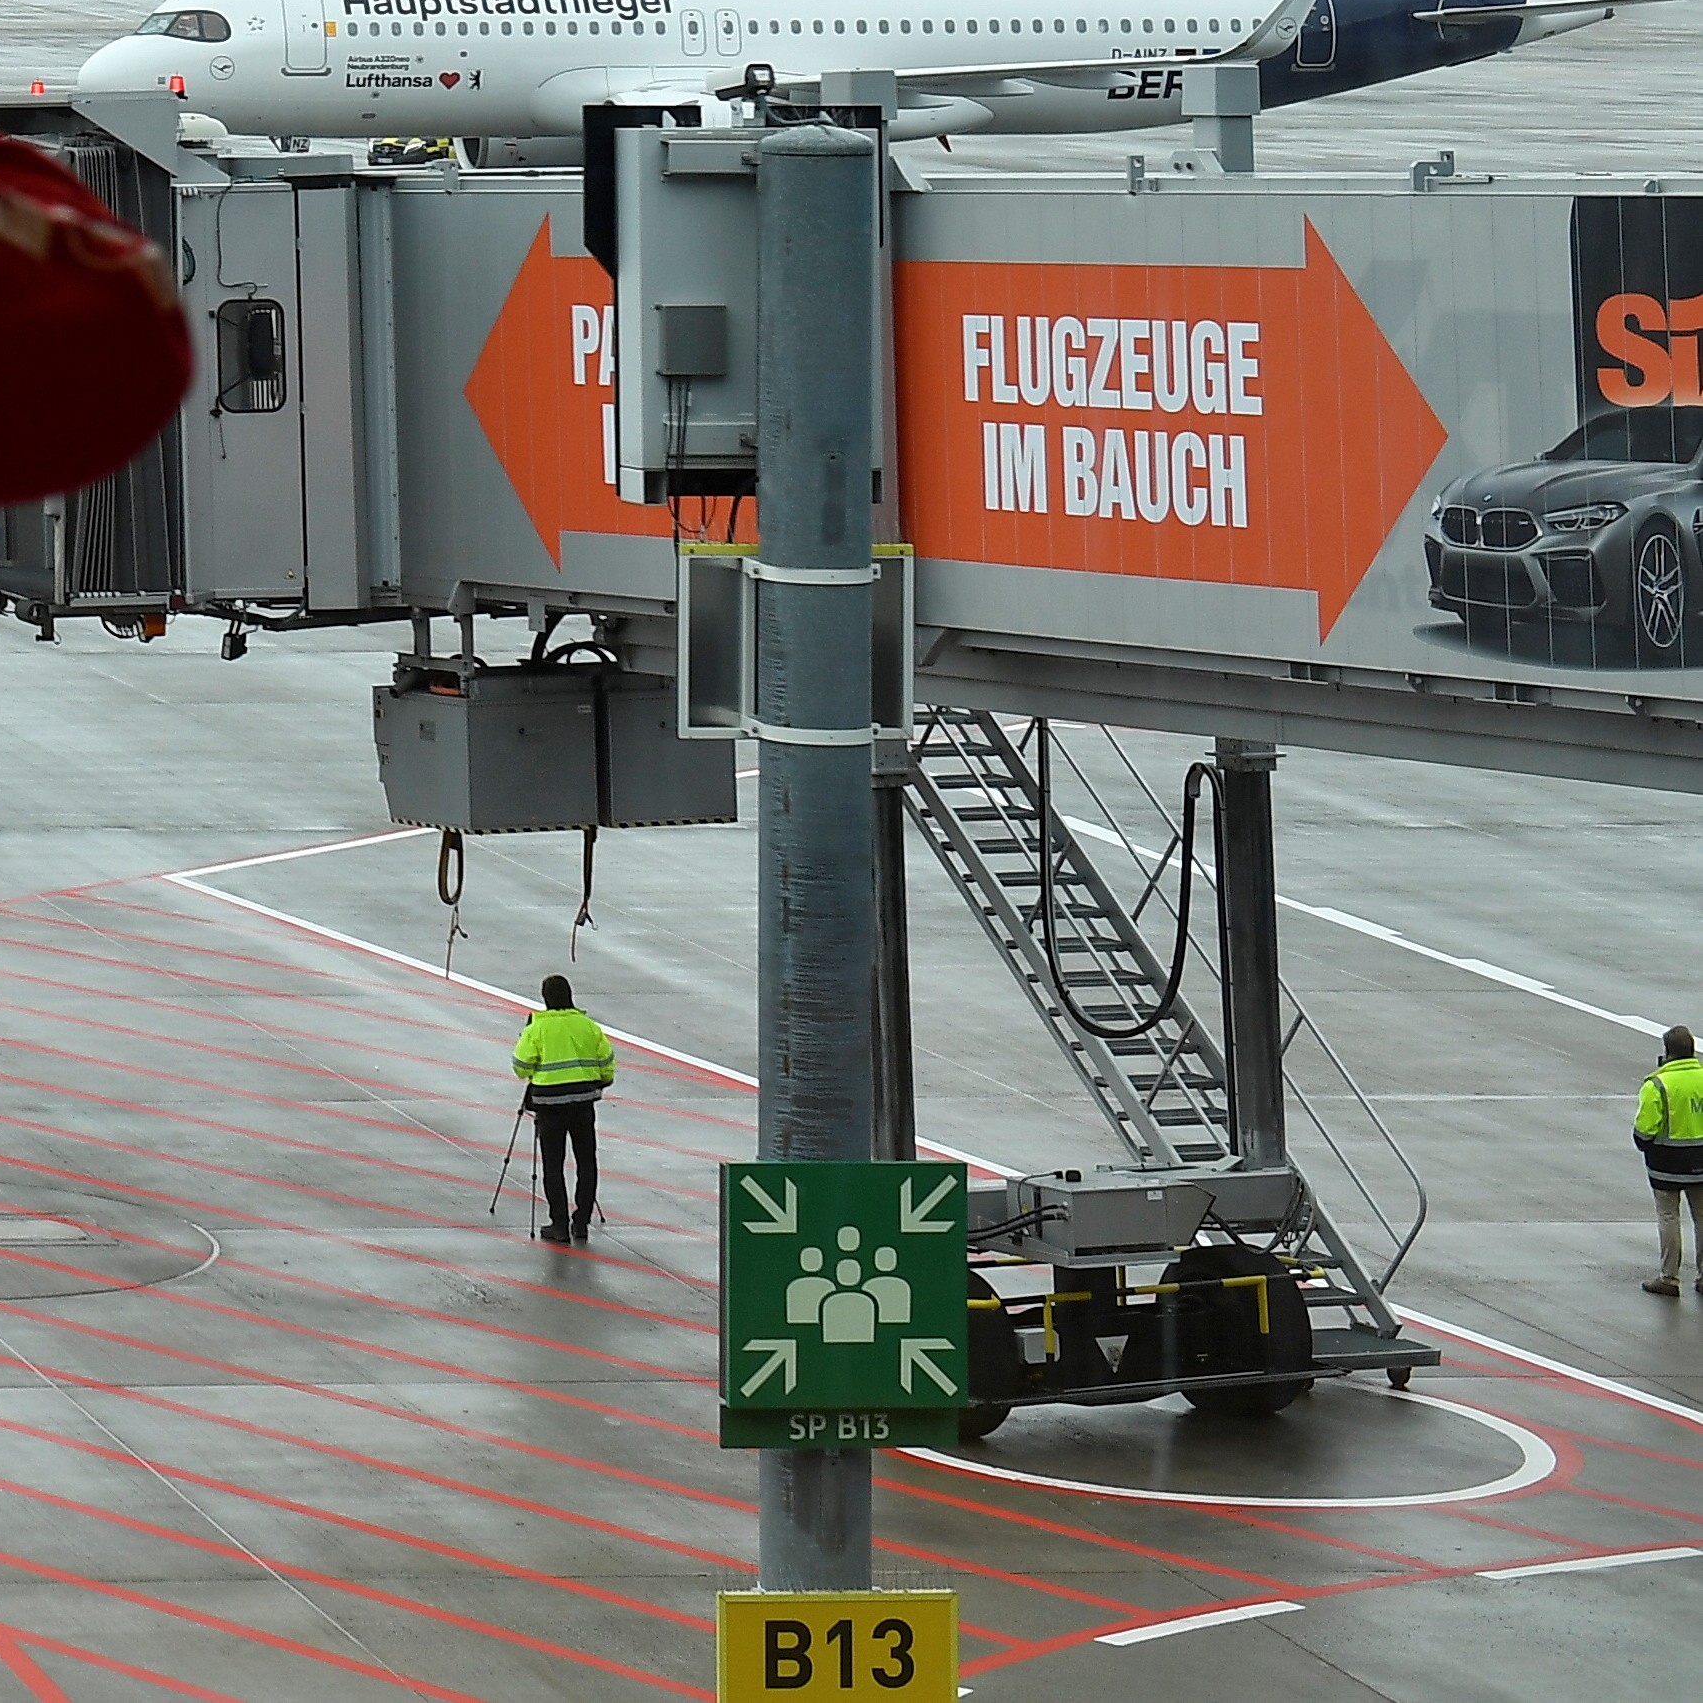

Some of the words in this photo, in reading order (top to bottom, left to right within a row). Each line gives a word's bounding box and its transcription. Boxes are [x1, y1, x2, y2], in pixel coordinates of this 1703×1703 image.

[347, 55, 373, 63] Airbus
[346, 73, 433, 88] Lufthansa
[292, 138, 309, 149] NZ
[962, 313, 1264, 417] FLUGZEUGE
[981, 421, 1048, 515] IM
[1062, 428, 1248, 529] BAUCH
[788, 1413, 828, 1440] SP
[838, 1413, 891, 1440] B13
[765, 1618, 915, 1690] B13
